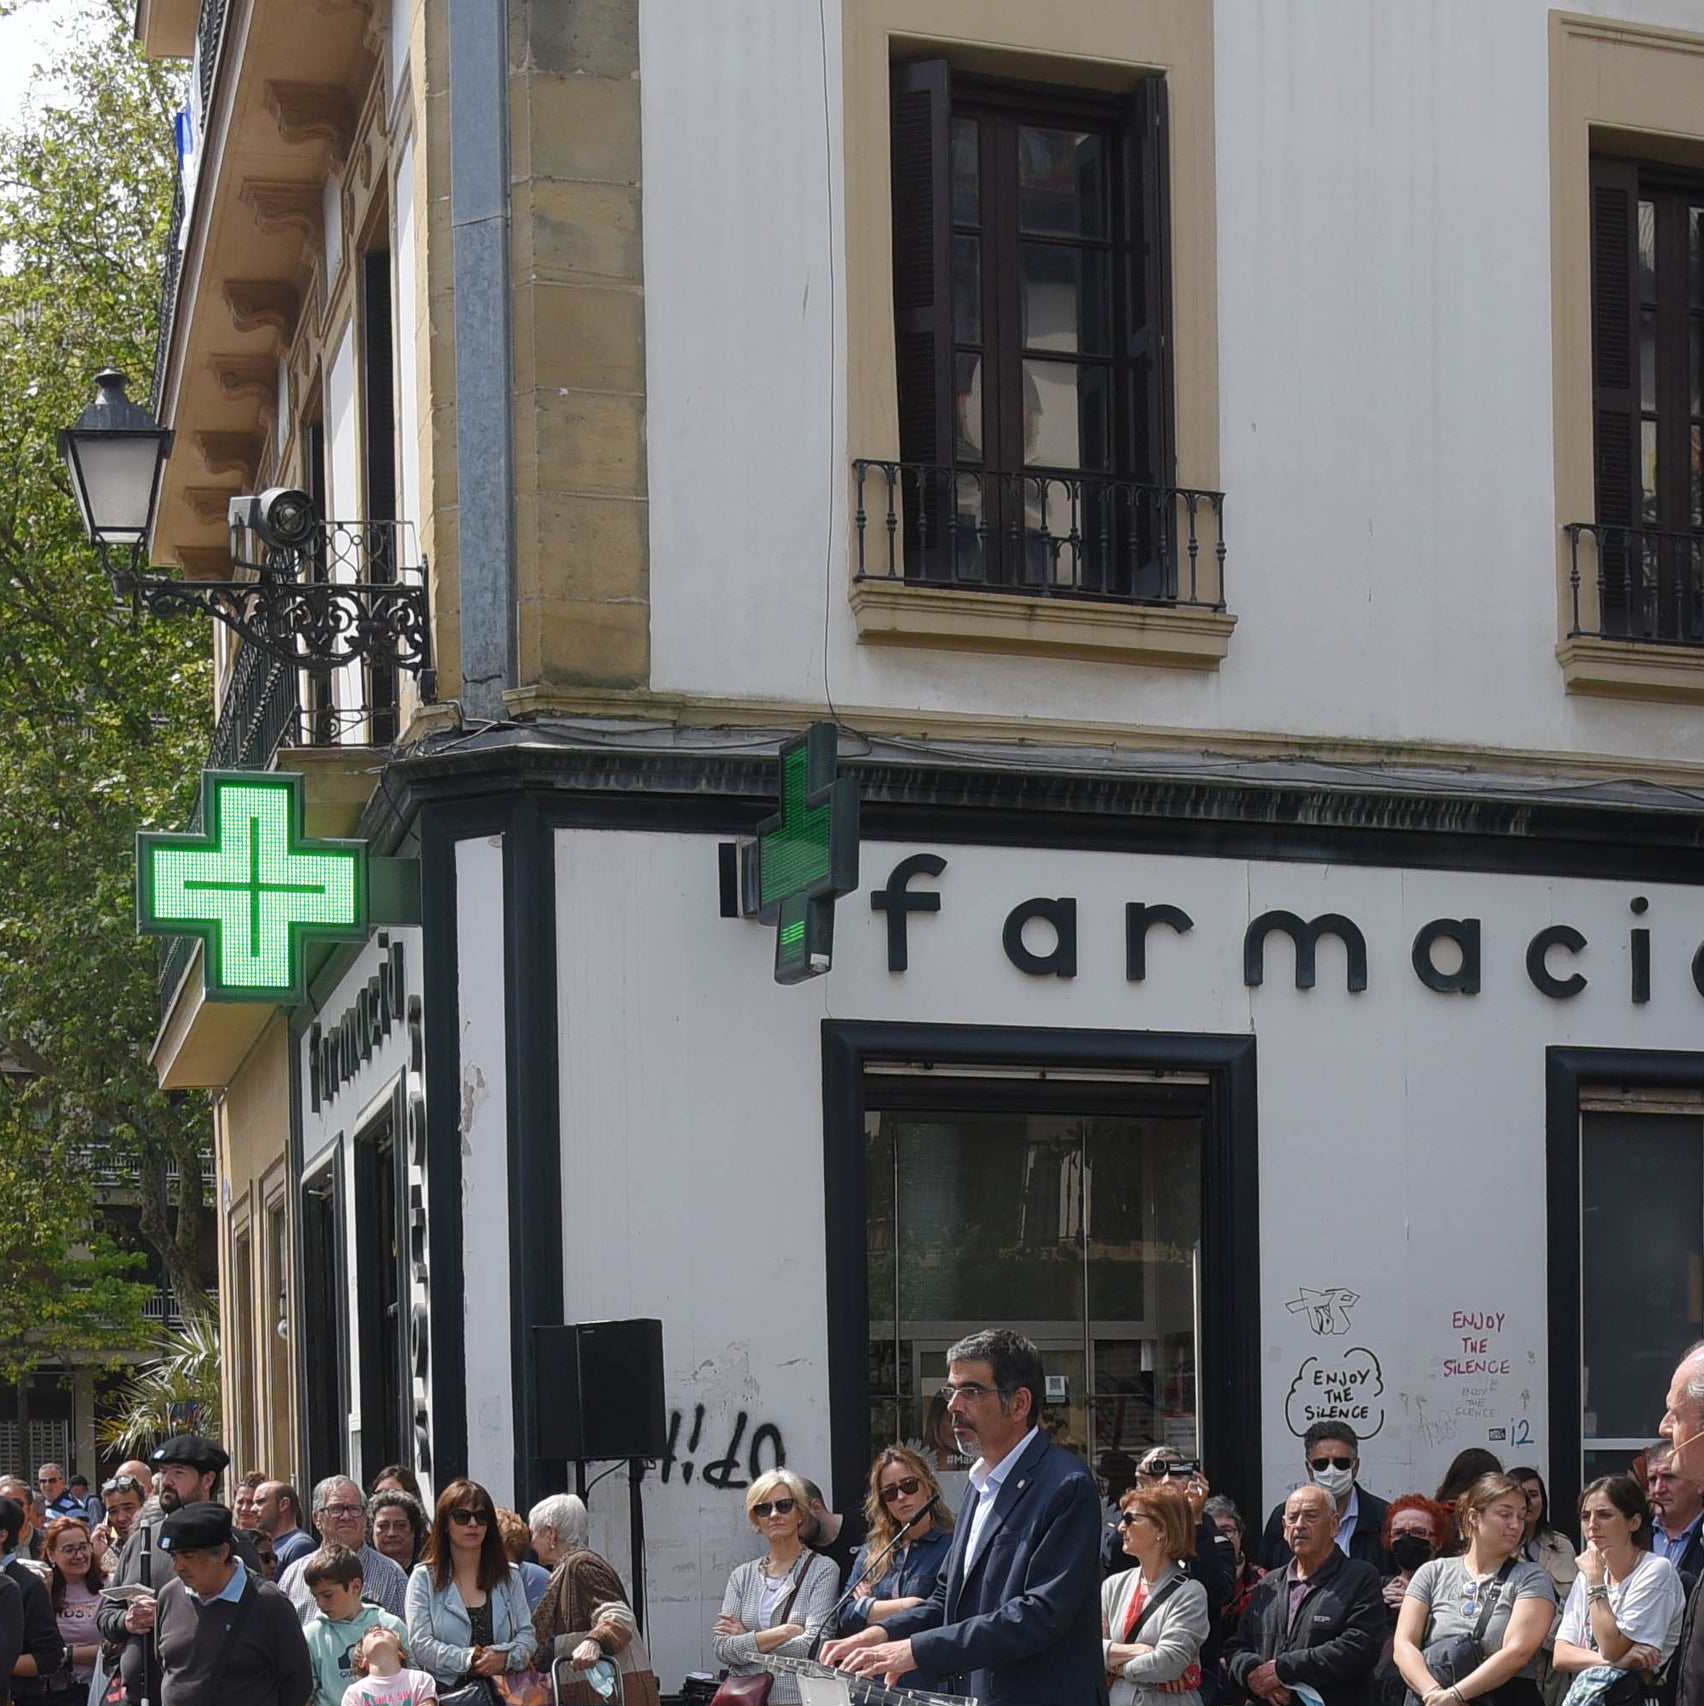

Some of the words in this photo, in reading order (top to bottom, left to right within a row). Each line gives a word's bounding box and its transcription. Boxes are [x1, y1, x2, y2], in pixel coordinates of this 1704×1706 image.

[1452, 1310, 1506, 1333] ENJOY
[1461, 1336, 1489, 1354] THE
[1312, 1368, 1371, 1386] ENJOY
[1323, 1386, 1354, 1404] THE
